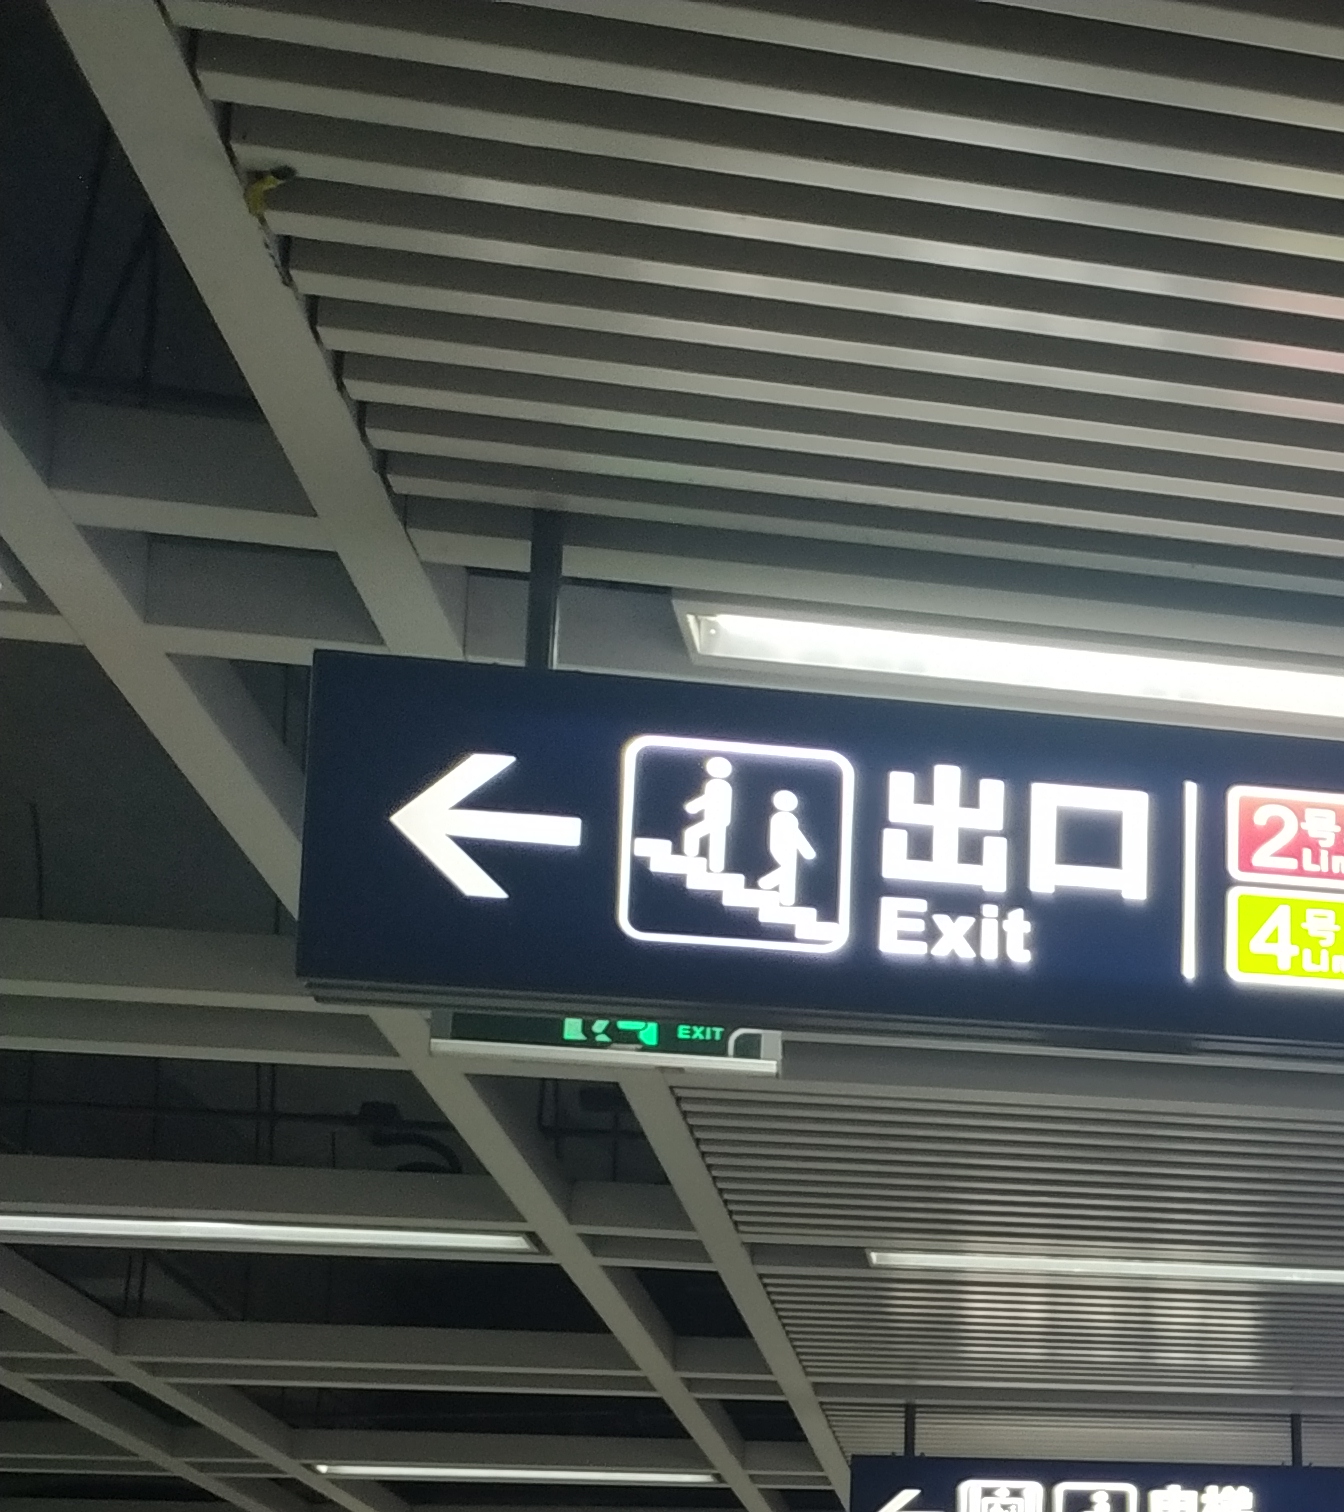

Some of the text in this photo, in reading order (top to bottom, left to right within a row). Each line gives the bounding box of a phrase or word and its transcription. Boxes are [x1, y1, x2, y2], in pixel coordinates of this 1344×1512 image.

[880, 763, 1151, 902] 出口
[877, 896, 1033, 964] Exit
[676, 1023, 725, 1042] EXIT
